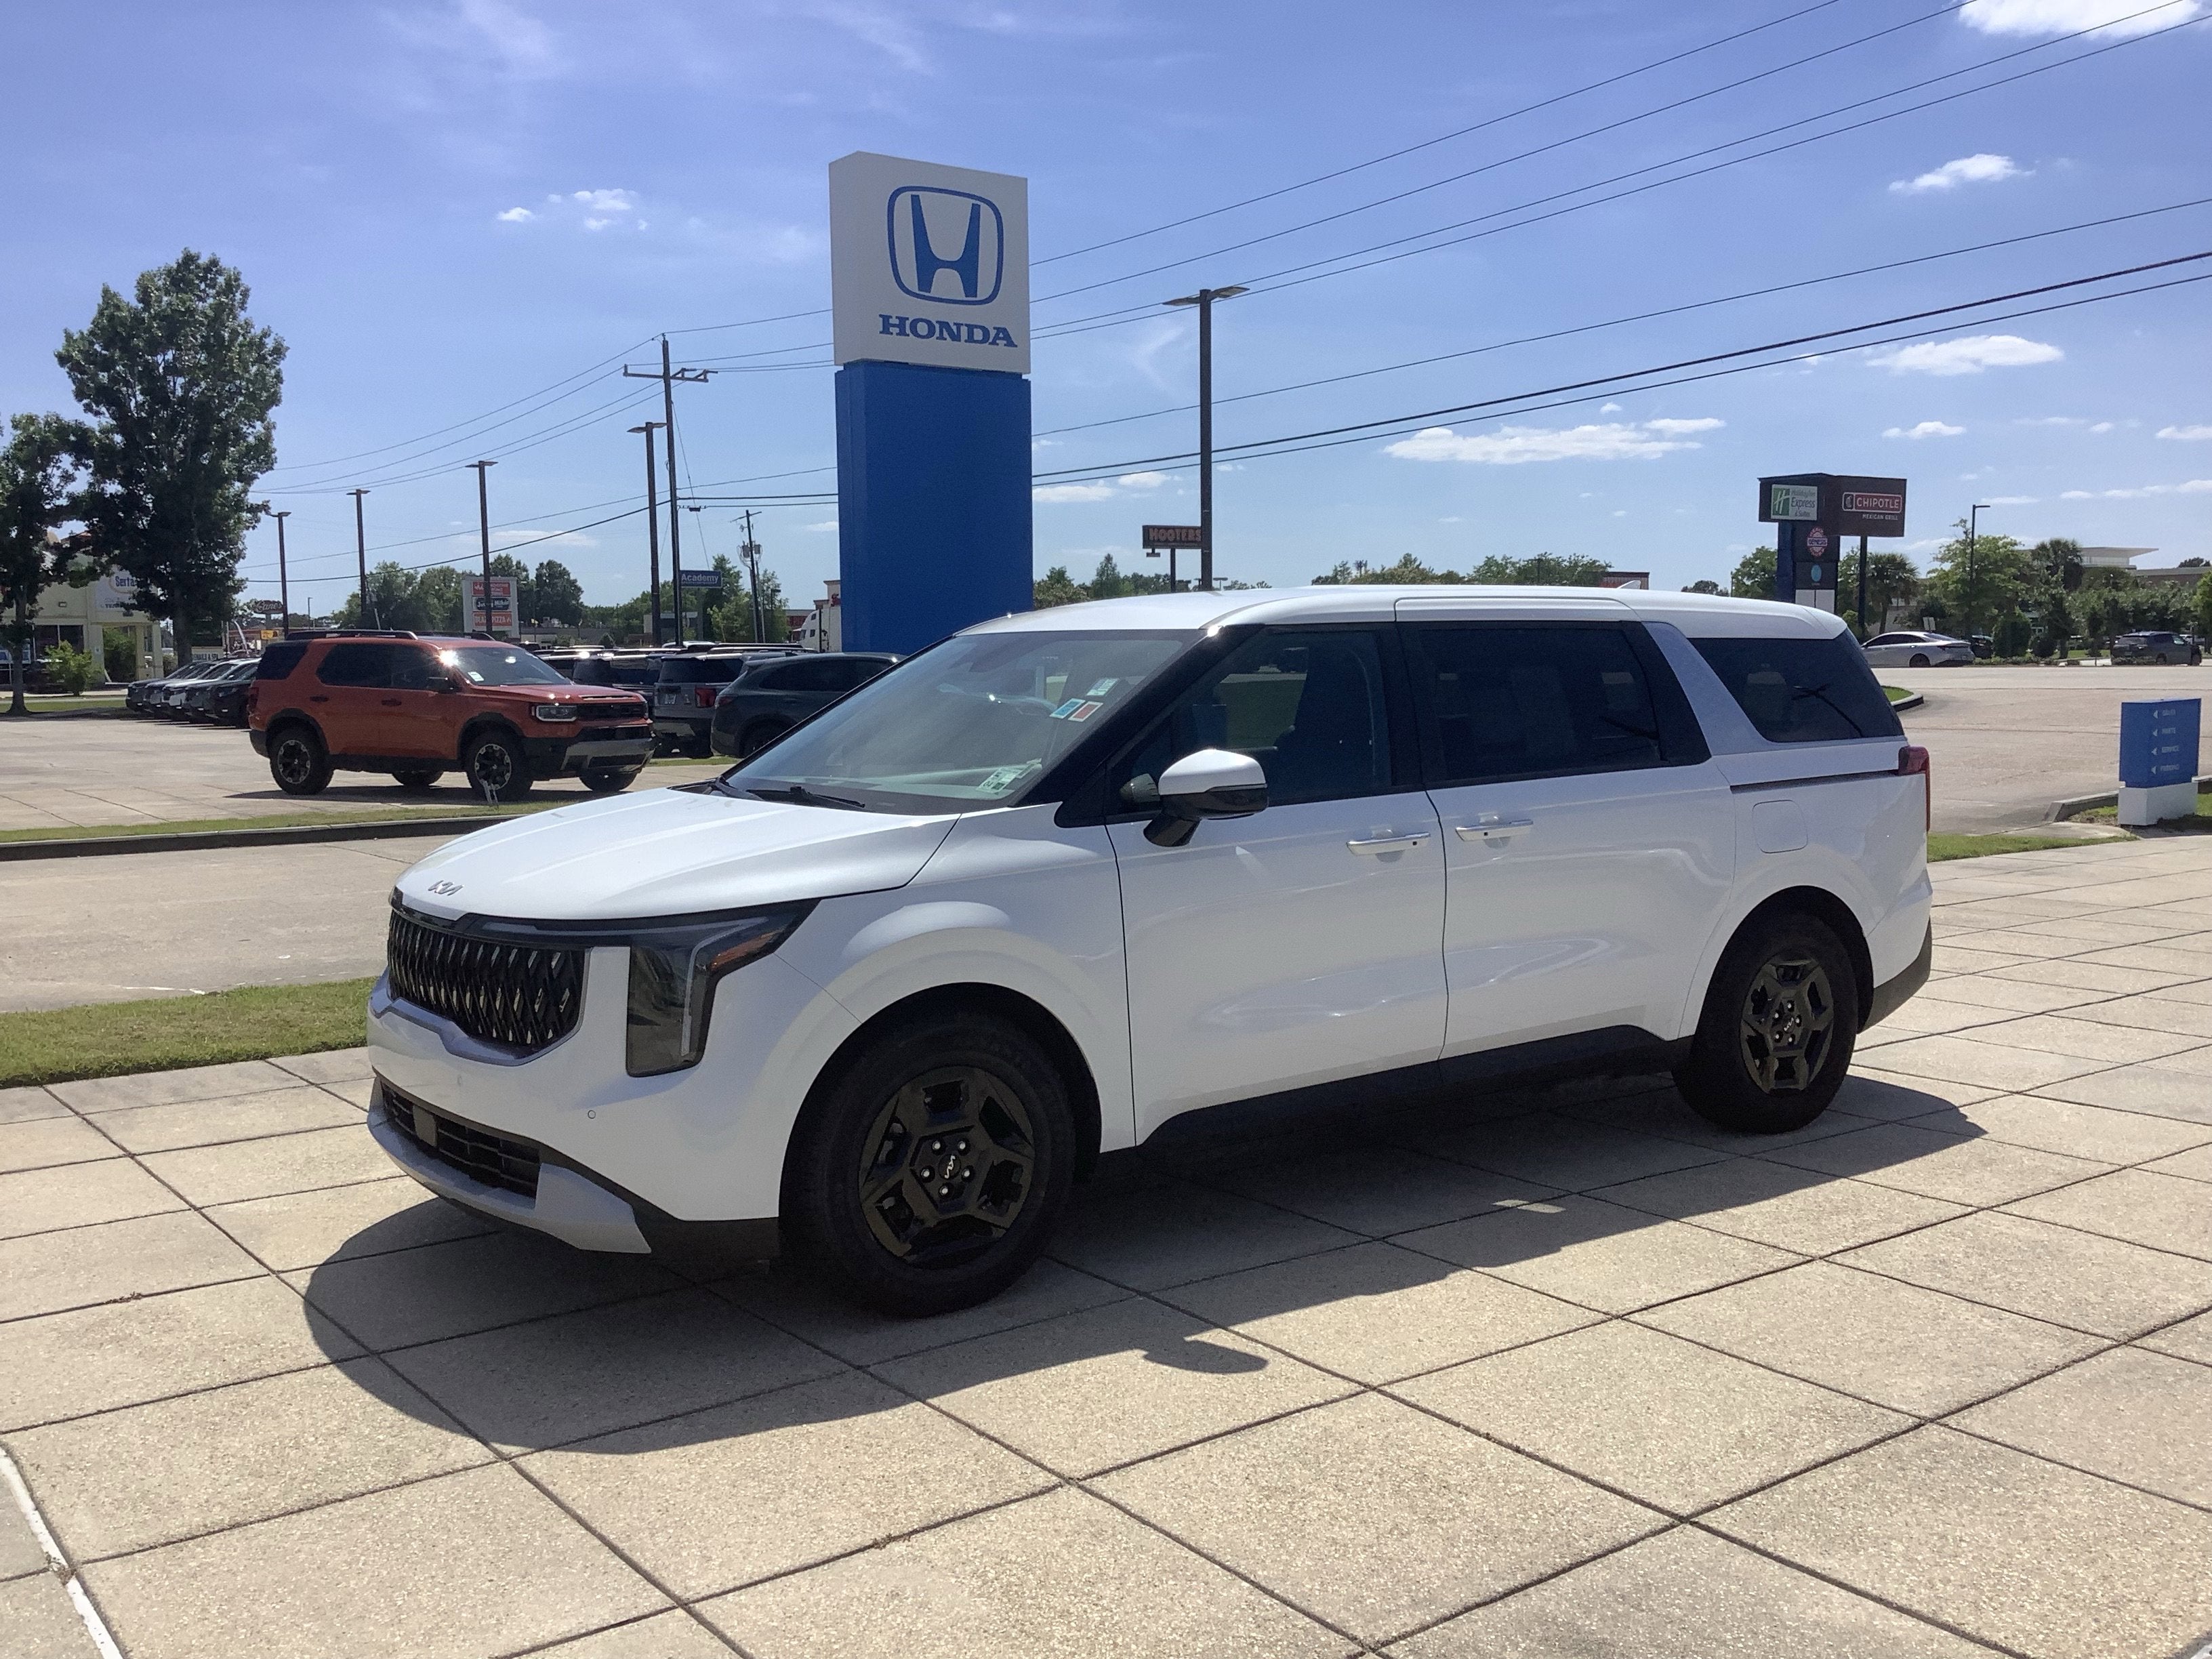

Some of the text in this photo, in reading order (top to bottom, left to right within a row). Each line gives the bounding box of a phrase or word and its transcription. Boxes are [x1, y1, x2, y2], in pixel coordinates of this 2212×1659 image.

[878, 314, 1018, 348] HONDA
[1790, 497, 1816, 510] Express
[1857, 497, 1900, 508] CHIPOTLE
[1149, 528, 1201, 541] HOOTERS
[115, 576, 136, 587] Serta
[681, 573, 719, 583] Academy
